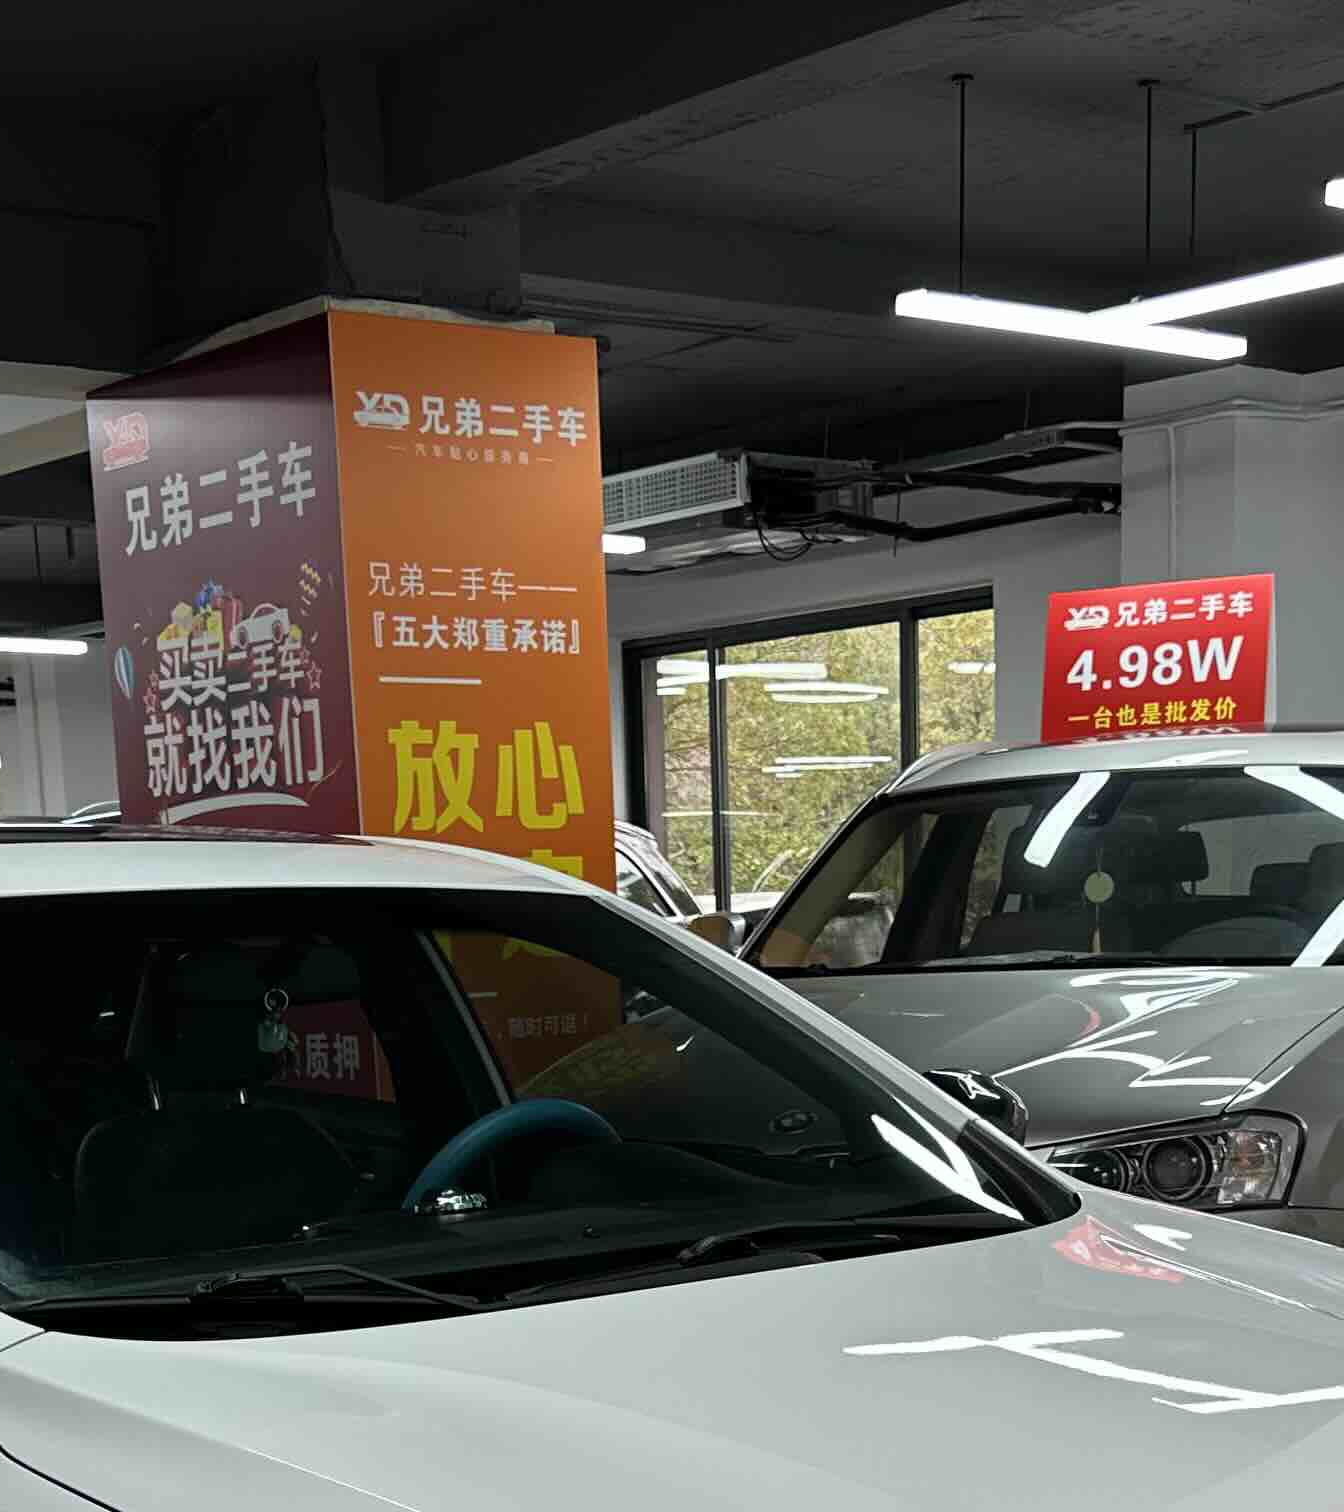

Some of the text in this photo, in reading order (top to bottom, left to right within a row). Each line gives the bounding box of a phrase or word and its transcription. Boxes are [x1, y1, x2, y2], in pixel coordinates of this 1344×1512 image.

[420, 395, 588, 447] 兄弟二手车
[125, 440, 316, 556] 兄弟二手车
[1114, 591, 1255, 628] 兄弟二手车
[158, 634, 306, 711] 买卖二手车
[1066, 635, 1245, 691] 4.98W
[1067, 695, 1237, 729] 一台也是批发价
[143, 697, 325, 798] 就找我们
[387, 719, 585, 834] 放心
